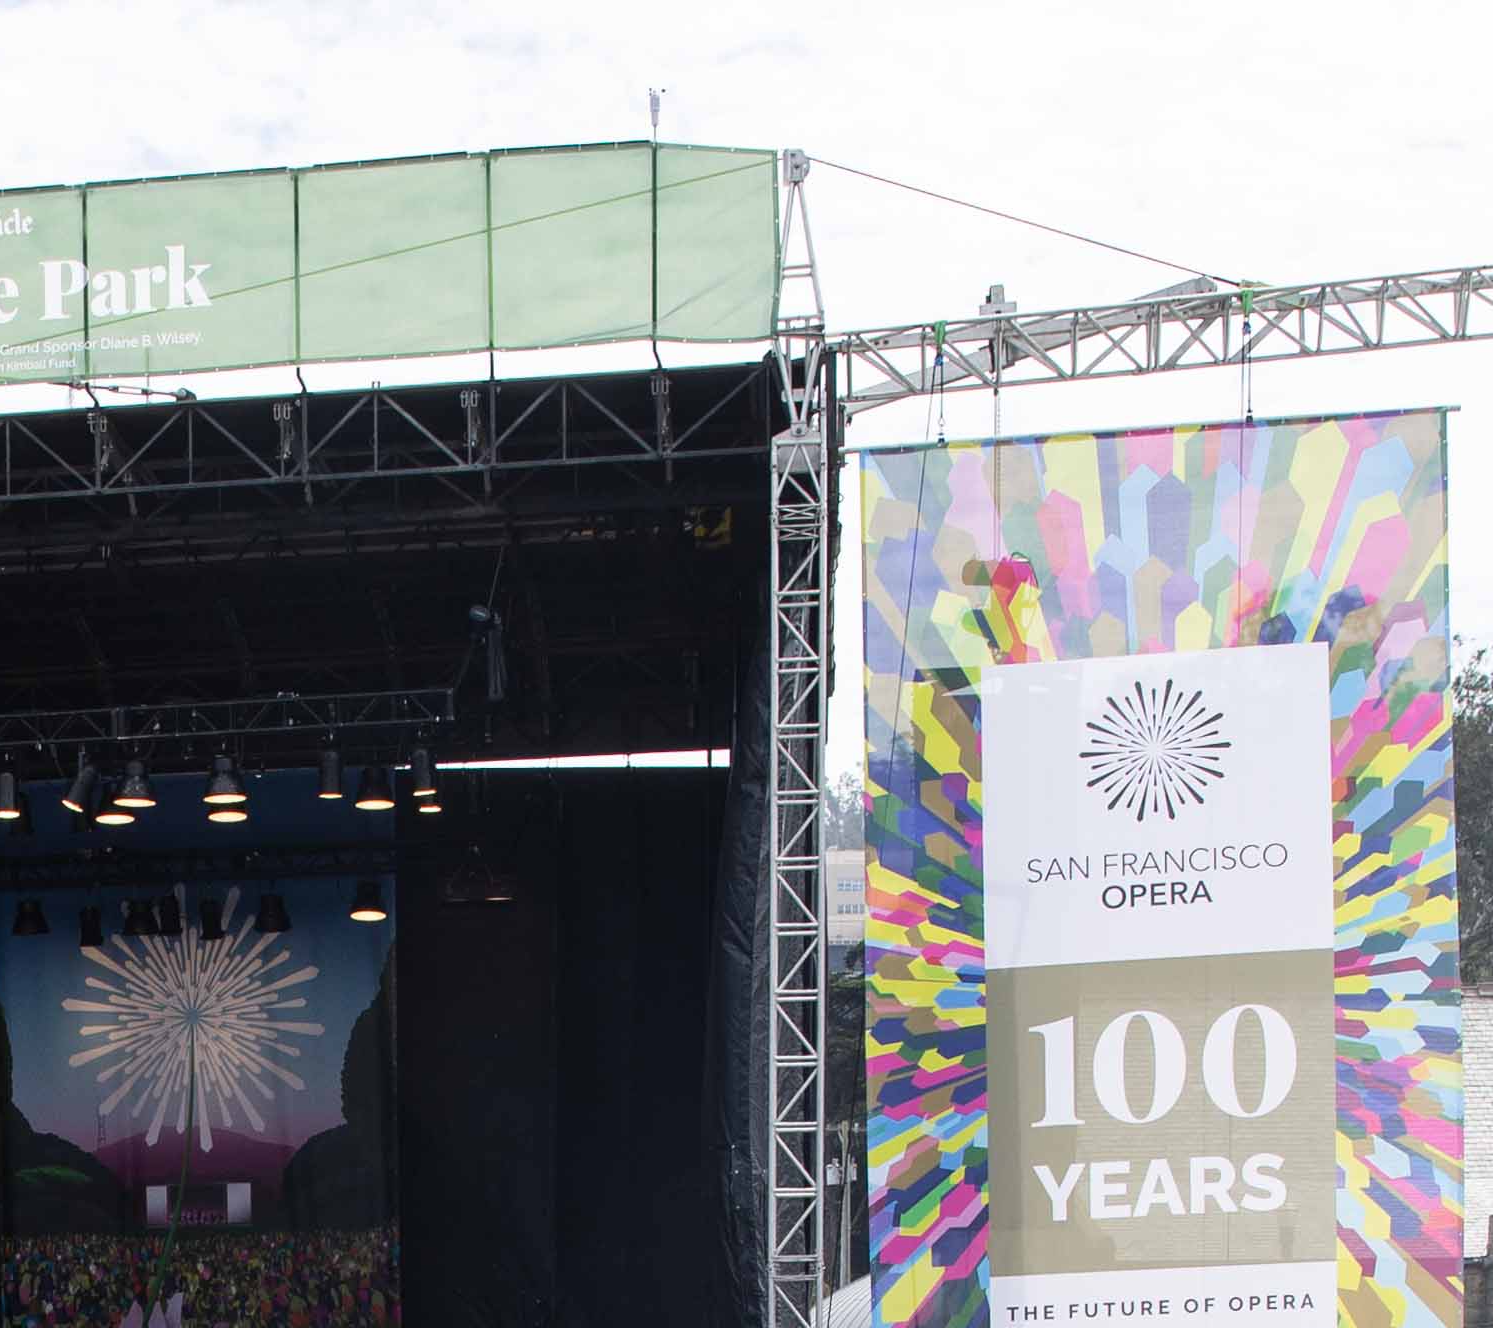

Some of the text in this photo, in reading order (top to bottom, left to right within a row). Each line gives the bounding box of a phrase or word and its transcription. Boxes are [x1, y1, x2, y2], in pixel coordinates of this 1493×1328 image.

[38, 244, 213, 320] Park
[0, 340, 39, 357] Grand
[42, 337, 100, 357] Sponsor
[101, 332, 138, 350] Diane
[1027, 842, 1288, 883] SAN FRANCISCO
[1101, 880, 1213, 909] OPERA
[1028, 1003, 1297, 1128] 100
[1032, 1152, 1288, 1222] YEARS
[1007, 1293, 1314, 1322] THE FUTURE OF OPERA
